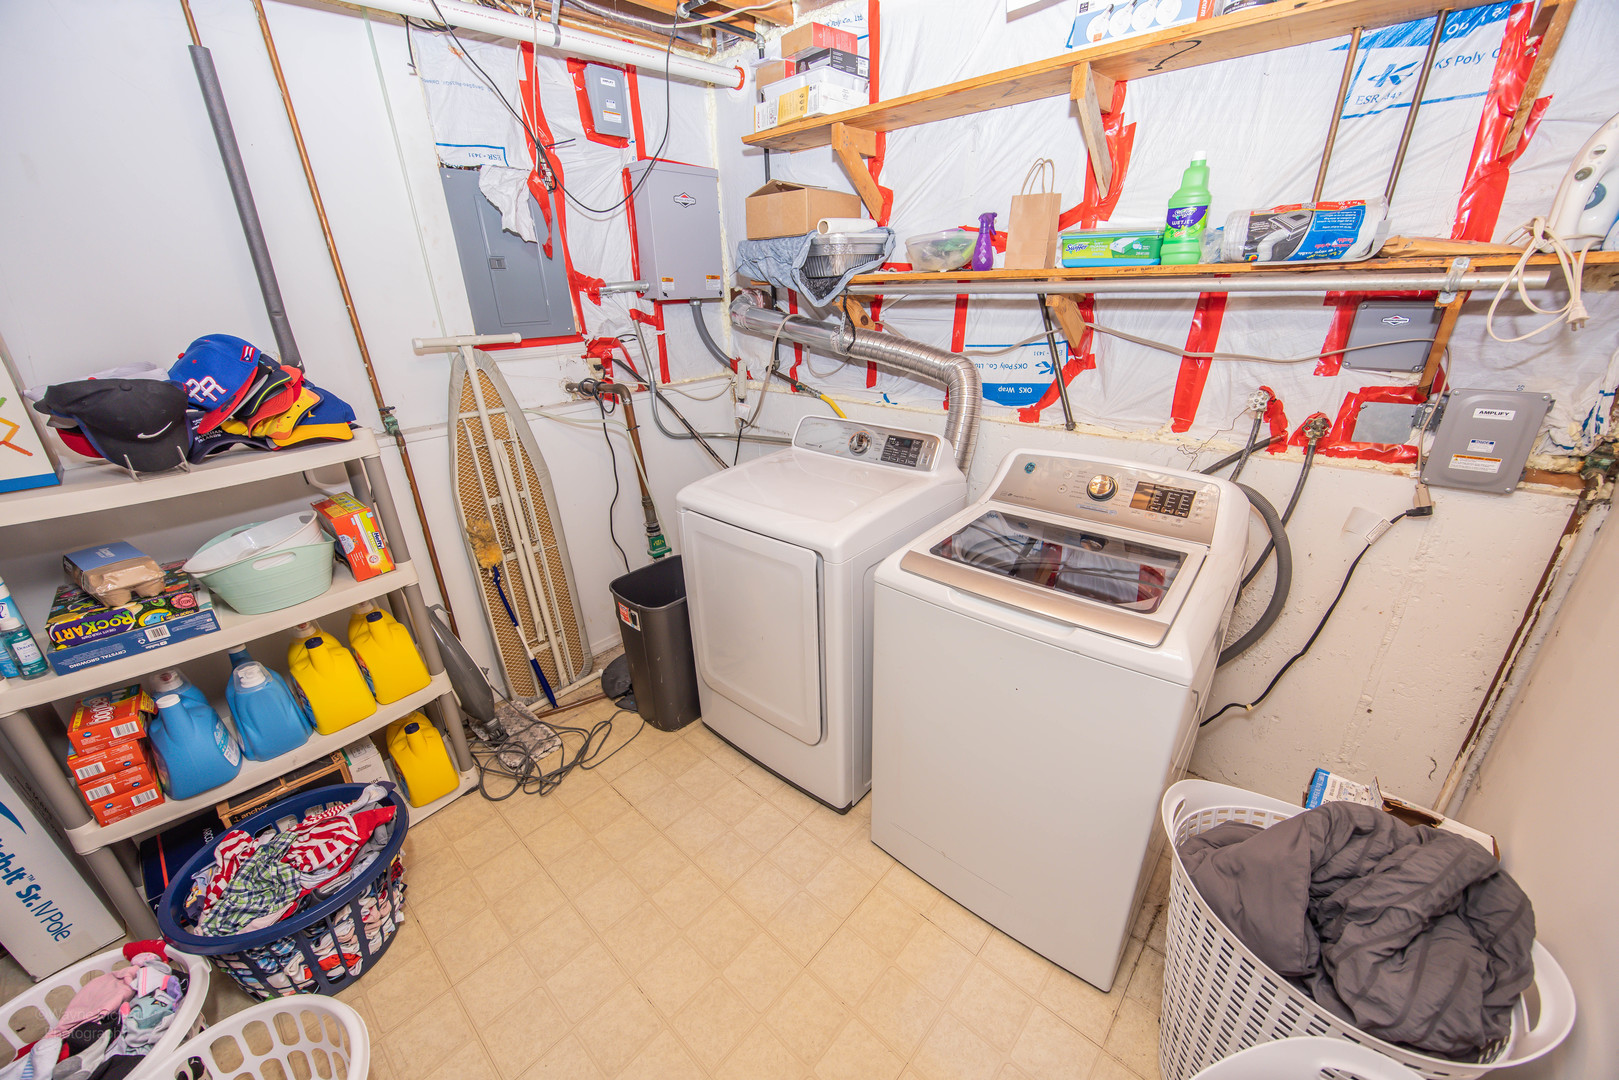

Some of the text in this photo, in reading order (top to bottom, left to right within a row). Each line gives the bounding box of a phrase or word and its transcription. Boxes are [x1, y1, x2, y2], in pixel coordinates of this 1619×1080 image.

[1454, 51, 1486, 67] Poly
[1355, 93, 1380, 105] ESR
[1065, 243, 1088, 253] Swiffer
[999, 362, 1013, 370] Poly
[1014, 362, 1028, 370] OKS
[997, 385, 1033, 394] OKS Wrap
[373, 532, 383, 549] Hefty
[68, 649, 127, 669] CRYSTAL GROWING
[240, 803, 269, 821] anchor
[15, 883, 42, 908] Sr.
[39, 912, 73, 942] Pole
